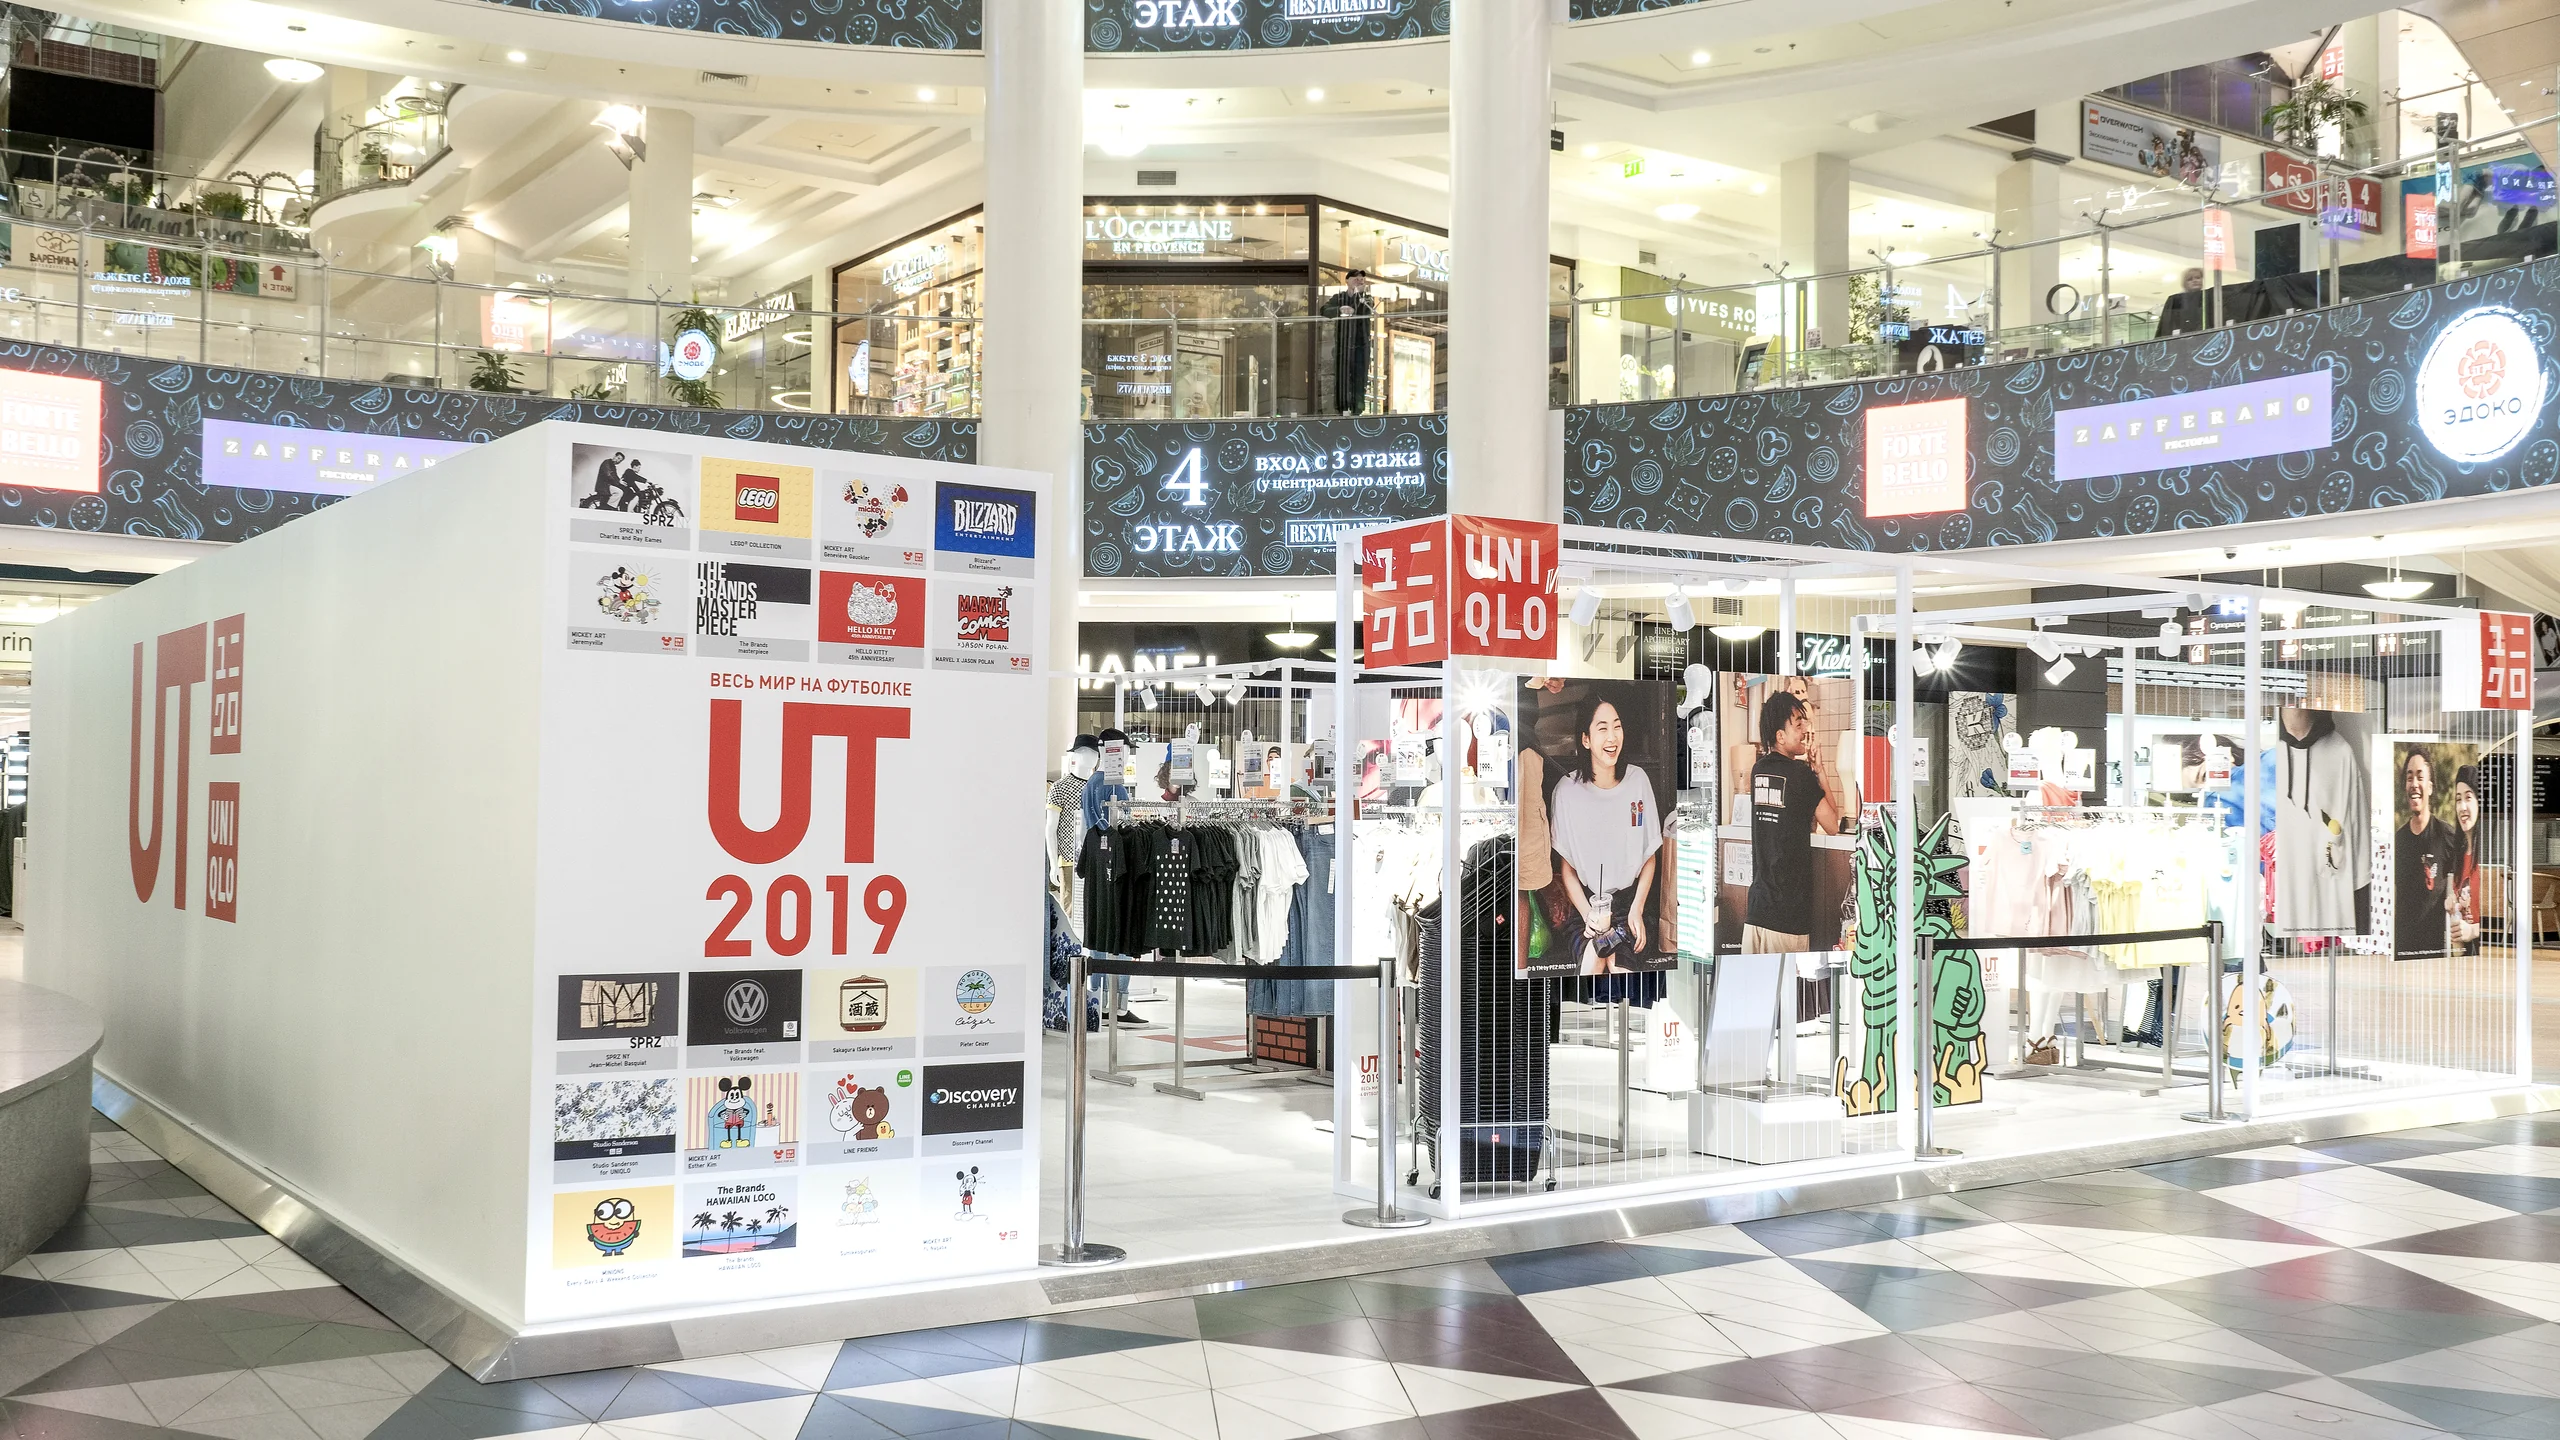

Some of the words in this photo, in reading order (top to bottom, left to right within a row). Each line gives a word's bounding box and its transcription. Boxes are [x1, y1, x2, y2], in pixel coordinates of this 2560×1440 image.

[1135, 0, 1240, 28] ЭТАЖ
[2100, 115, 2144, 134] OVERWATCH
[2361, 183, 2370, 205] 4
[2353, 207, 2377, 228] ЭТАЖ
[1085, 216, 1233, 240] L'OCCITANE
[1113, 242, 1131, 253] EN
[1135, 242, 1205, 253] PROVENCE
[269, 284, 294, 293] ЭТАЖ
[1688, 297, 1729, 319] YVES
[2, 399, 80, 433] FORTE
[2076, 396, 2311, 444] ZAFFERANO
[2444, 397, 2522, 426] ЭДОКО
[2, 429, 80, 459] BELLO
[1882, 431, 1948, 460] FORTE
[1255, 455, 1310, 473] вход
[1314, 456, 1327, 470] с
[1331, 450, 1346, 470] 3
[1350, 450, 1423, 469] этажа
[1166, 447, 1209, 507] 4
[1882, 458, 1948, 486] BELLO
[1255, 476, 1274, 493] (у
[1275, 474, 1373, 492] центрального
[1375, 471, 1426, 490] лифта)
[737, 488, 777, 508] LEGO
[858, 505, 884, 516] mickey
[953, 499, 1017, 535] BLIZZARD
[643, 513, 674, 527] SPRZ
[599, 532, 620, 541] Charles
[622, 534, 632, 542] and
[633, 535, 643, 544] Ray
[644, 536, 662, 544] Eames
[749, 541, 782, 550] COLLECTION
[955, 532, 1015, 542] ENTERTAINMENT
[1134, 523, 1241, 553] ЭТАЖ
[848, 553, 870, 561] Gauckler
[1464, 533, 1540, 585] UNI
[697, 560, 727, 581] THE
[968, 563, 1001, 572] Entertainment
[1372, 540, 1433, 592] ユニ
[697, 579, 758, 601] BRANDS
[696, 599, 758, 620] MASTER
[958, 594, 1009, 613] MARVEL
[696, 615, 738, 637] PIECE
[957, 614, 1010, 635] COMICS
[1371, 599, 1435, 653] クロ
[1464, 591, 1548, 648] QLO
[847, 624, 873, 635] HELLO
[873, 626, 897, 636] KITTY
[861, 633, 893, 641] ANNIVERSARY
[571, 638, 604, 647] Jeremyville
[1643, 635, 1691, 646] APOTHECARY
[2488, 624, 2527, 659] ユニ
[216, 632, 240, 680] ユニ
[737, 648, 769, 656] masterpiece
[1648, 644, 1685, 655] SKINCARE
[848, 654, 859, 662] 45th
[860, 655, 896, 663] ANNIVERSARY
[935, 655, 956, 664] MARVEL
[961, 657, 977, 665] JASON
[709, 672, 754, 688] ВЕСЬ
[759, 675, 796, 692] МИР
[800, 677, 823, 692] НА
[827, 678, 913, 696] ФУТБОЛКЕ
[2486, 667, 2527, 698] クロ
[213, 691, 239, 737] クロ
[129, 621, 208, 911] UT
[707, 698, 911, 865] UT
[210, 800, 234, 846] UNI
[209, 855, 234, 909] QLO
[704, 874, 907, 957] 2019
[1984, 956, 1999, 972] UT
[959, 978, 966, 987] NO
[966, 971, 993, 986] WORRIES
[848, 1001, 879, 1017] 酒蔵
[724, 1026, 768, 1036] Volkswagen
[1664, 1021, 1680, 1038] UT
[630, 1035, 662, 1049] SPRZ
[832, 1047, 856, 1055] Sakagura
[857, 1045, 871, 1053] (Sake
[871, 1045, 893, 1053] brewery)
[1664, 1037, 1681, 1047] 2019
[606, 1053, 621, 1061] SPRZ
[729, 1055, 760, 1063] Volkswagen
[754, 1047, 766, 1055] feat.
[589, 1060, 623, 1069] Jean-Michel
[624, 1060, 647, 1069] Basquiat
[937, 1088, 1018, 1105] Discovery
[966, 1101, 1007, 1110] CHANNEL
[592, 1139, 611, 1148] Studio
[611, 1138, 639, 1147] Sanderson
[843, 1147, 856, 1155] LINE
[857, 1146, 878, 1154] FRIENDS
[952, 1139, 974, 1147] Discovery
[592, 1161, 609, 1169] Studio
[610, 1160, 639, 1168] Sanderson
[609, 1167, 631, 1175] UNIQLO
[717, 1186, 734, 1195] The
[736, 1183, 766, 1193] Brands
[706, 1195, 751, 1206] HAWAIIAN
[753, 1192, 776, 1203] LOCO
[718, 1263, 746, 1271] HAWAIIAN
